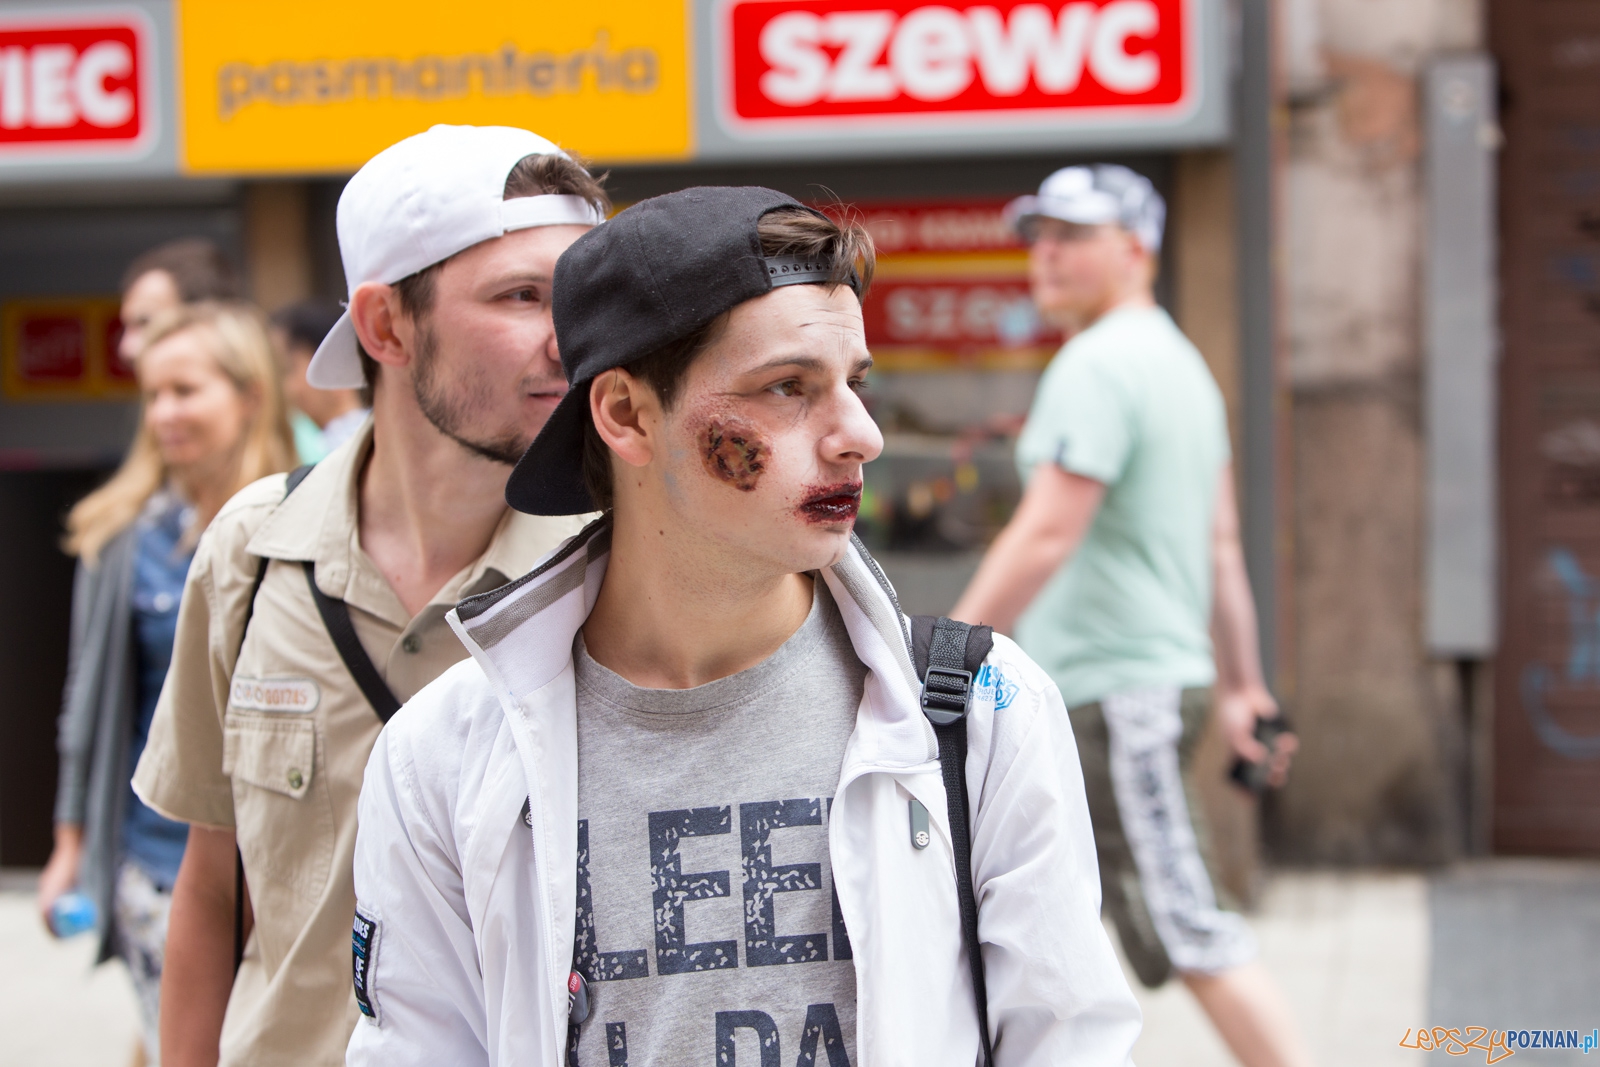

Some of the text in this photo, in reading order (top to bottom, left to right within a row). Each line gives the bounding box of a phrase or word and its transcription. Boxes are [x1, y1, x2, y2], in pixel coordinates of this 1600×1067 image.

[0, 39, 135, 130] IEC
[217, 28, 659, 122] pasmanteria
[758, 0, 1161, 107] szewc
